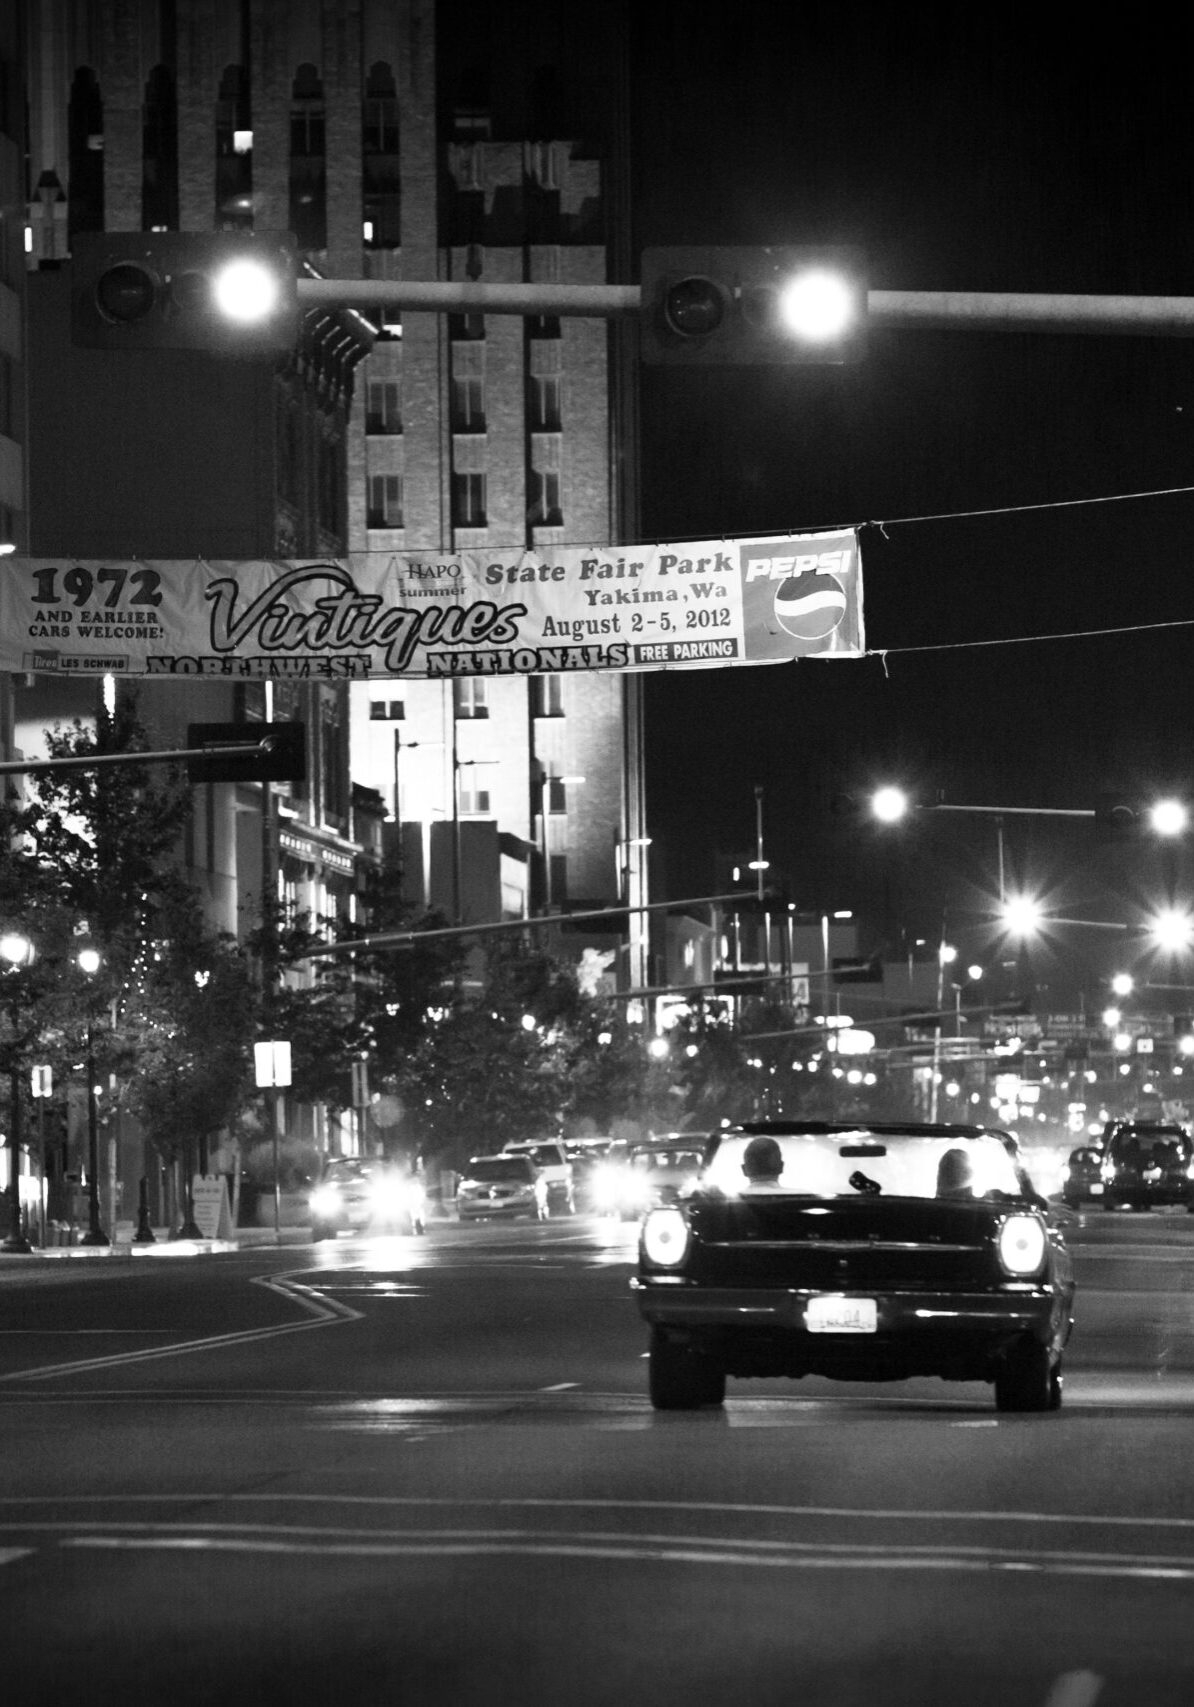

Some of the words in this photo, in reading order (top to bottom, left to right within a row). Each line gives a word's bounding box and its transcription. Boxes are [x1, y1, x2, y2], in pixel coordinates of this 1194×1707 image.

[401, 563, 461, 579] HAPO
[485, 563, 566, 585] State
[578, 558, 645, 581] Fair
[657, 552, 735, 576] Park
[745, 550, 851, 582] PEPSI
[31, 567, 163, 608] 1972
[399, 587, 467, 598] summer
[34, 610, 73, 623] AND
[80, 611, 159, 624] EARLIER
[204, 564, 528, 672] Vintiques
[541, 612, 621, 641] August
[686, 608, 731, 630] 2012
[28, 625, 71, 638] CARS
[77, 626, 164, 639] WELCOME!
[61, 658, 80, 669] LES
[83, 658, 125, 669] SCHWAB
[147, 654, 372, 678] NORTHWEST
[427, 642, 629, 678] NATIONALS
[640, 645, 669, 661] FREE
[674, 640, 734, 659] PARKING
